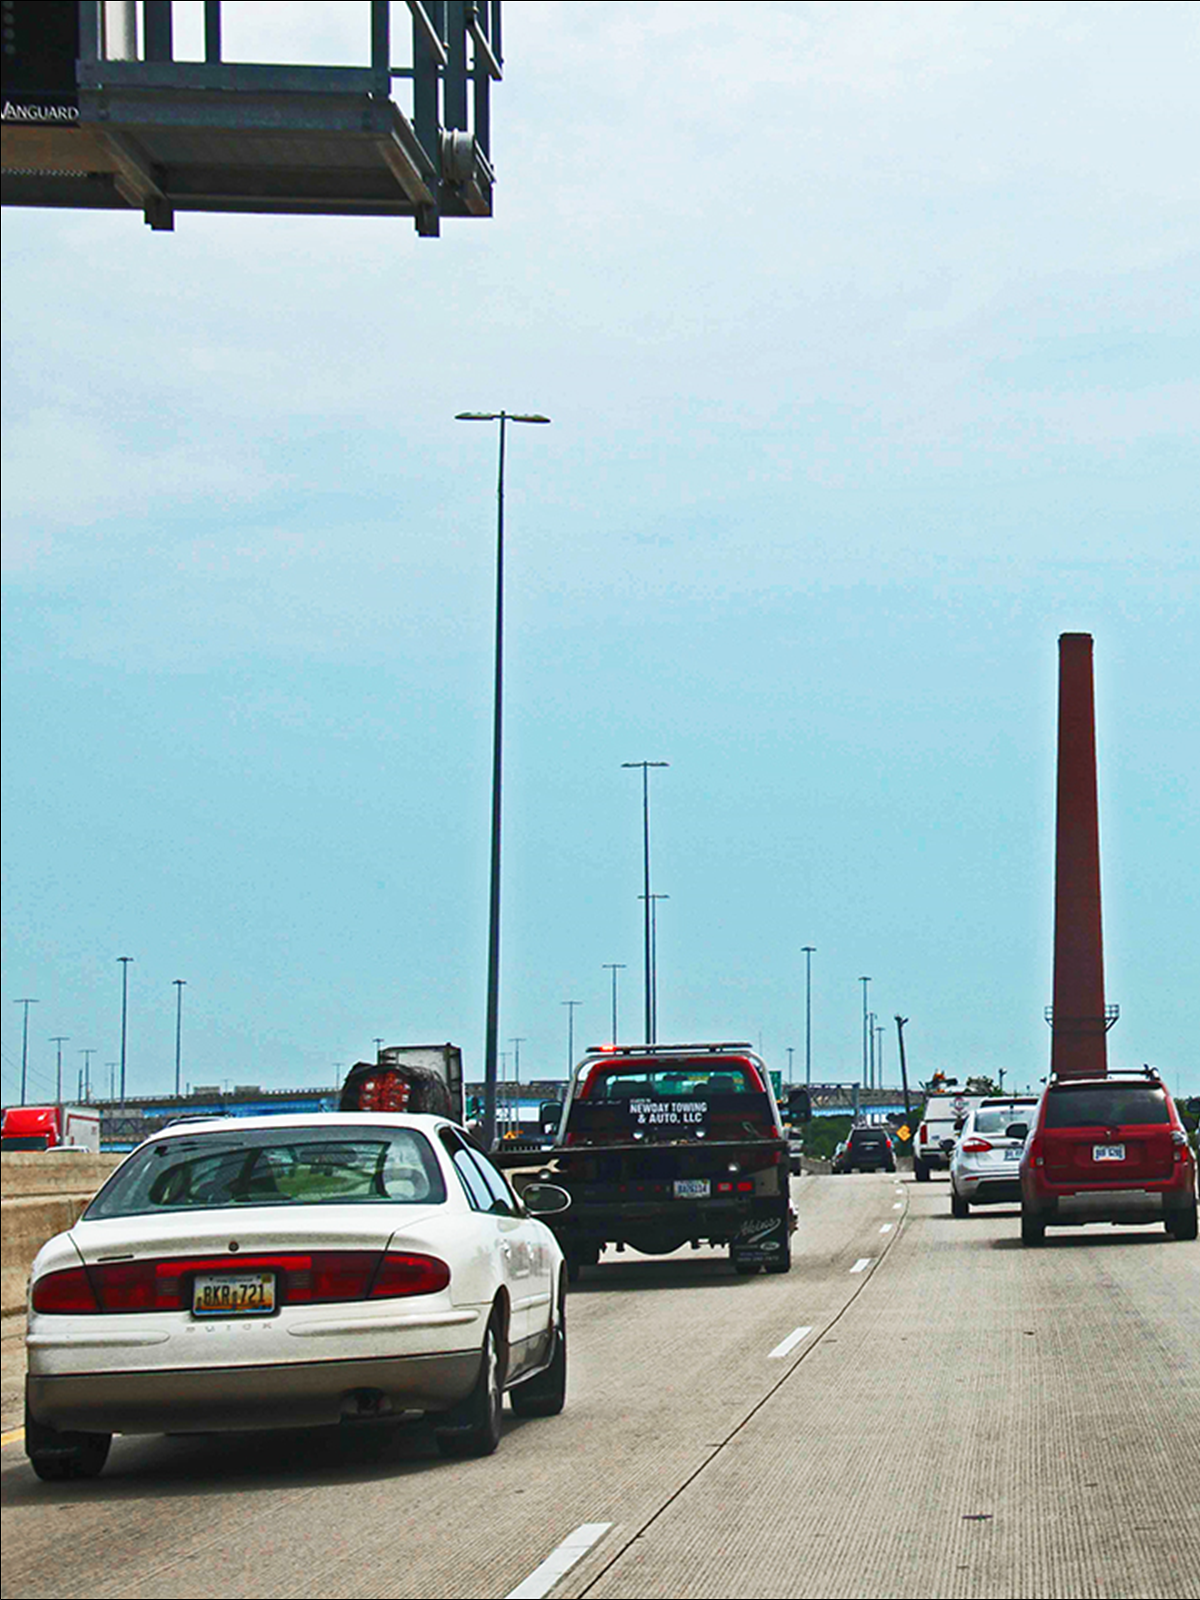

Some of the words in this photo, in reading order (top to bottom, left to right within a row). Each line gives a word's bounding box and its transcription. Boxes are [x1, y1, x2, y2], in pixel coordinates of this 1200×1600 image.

[629, 1102, 669, 1114] NEWDAY
[671, 1101, 708, 1113] TOWING
[637, 1113, 646, 1124] &
[683, 1112, 702, 1123] LLC
